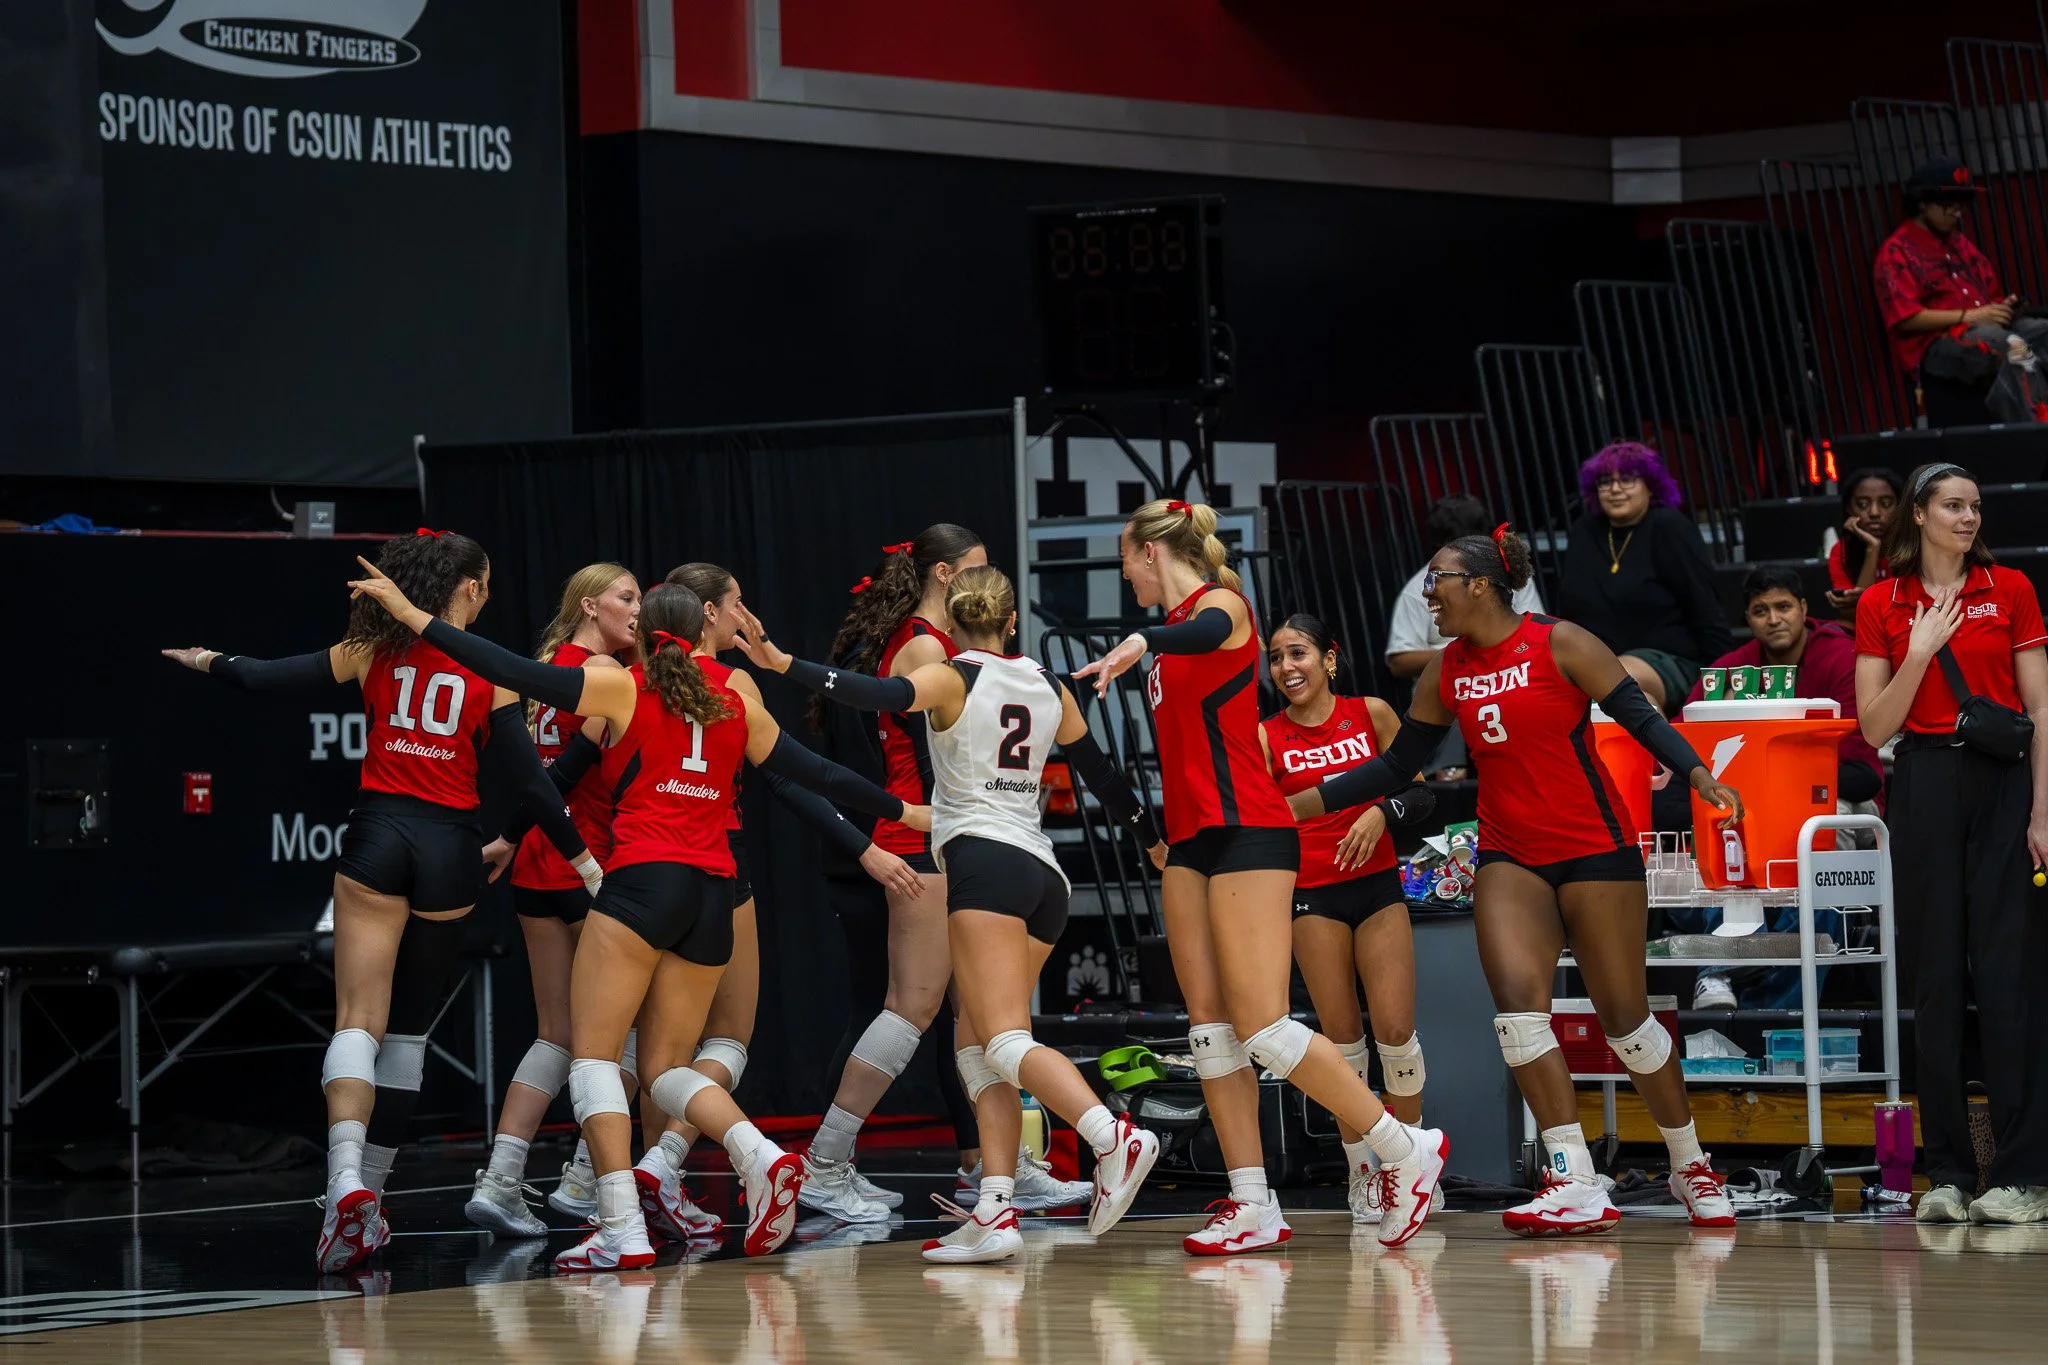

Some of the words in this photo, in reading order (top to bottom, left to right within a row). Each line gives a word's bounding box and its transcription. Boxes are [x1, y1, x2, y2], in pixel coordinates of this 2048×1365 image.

[99, 91, 234, 150] SPONSOR
[243, 105, 278, 154] OF
[287, 109, 363, 162] CSUN
[371, 116, 512, 172] ATHLETICS
[1967, 602, 1998, 615] CSUN
[388, 665, 467, 738] 10
[1454, 661, 1531, 701] CSUN
[681, 711, 708, 774] 1
[998, 704, 1031, 771] 2
[1477, 703, 1508, 744] 3
[385, 738, 457, 760] Matadors
[1282, 731, 1372, 773] CSUN
[655, 779, 721, 800] Matadors
[1815, 871, 1876, 887] GATORADE
